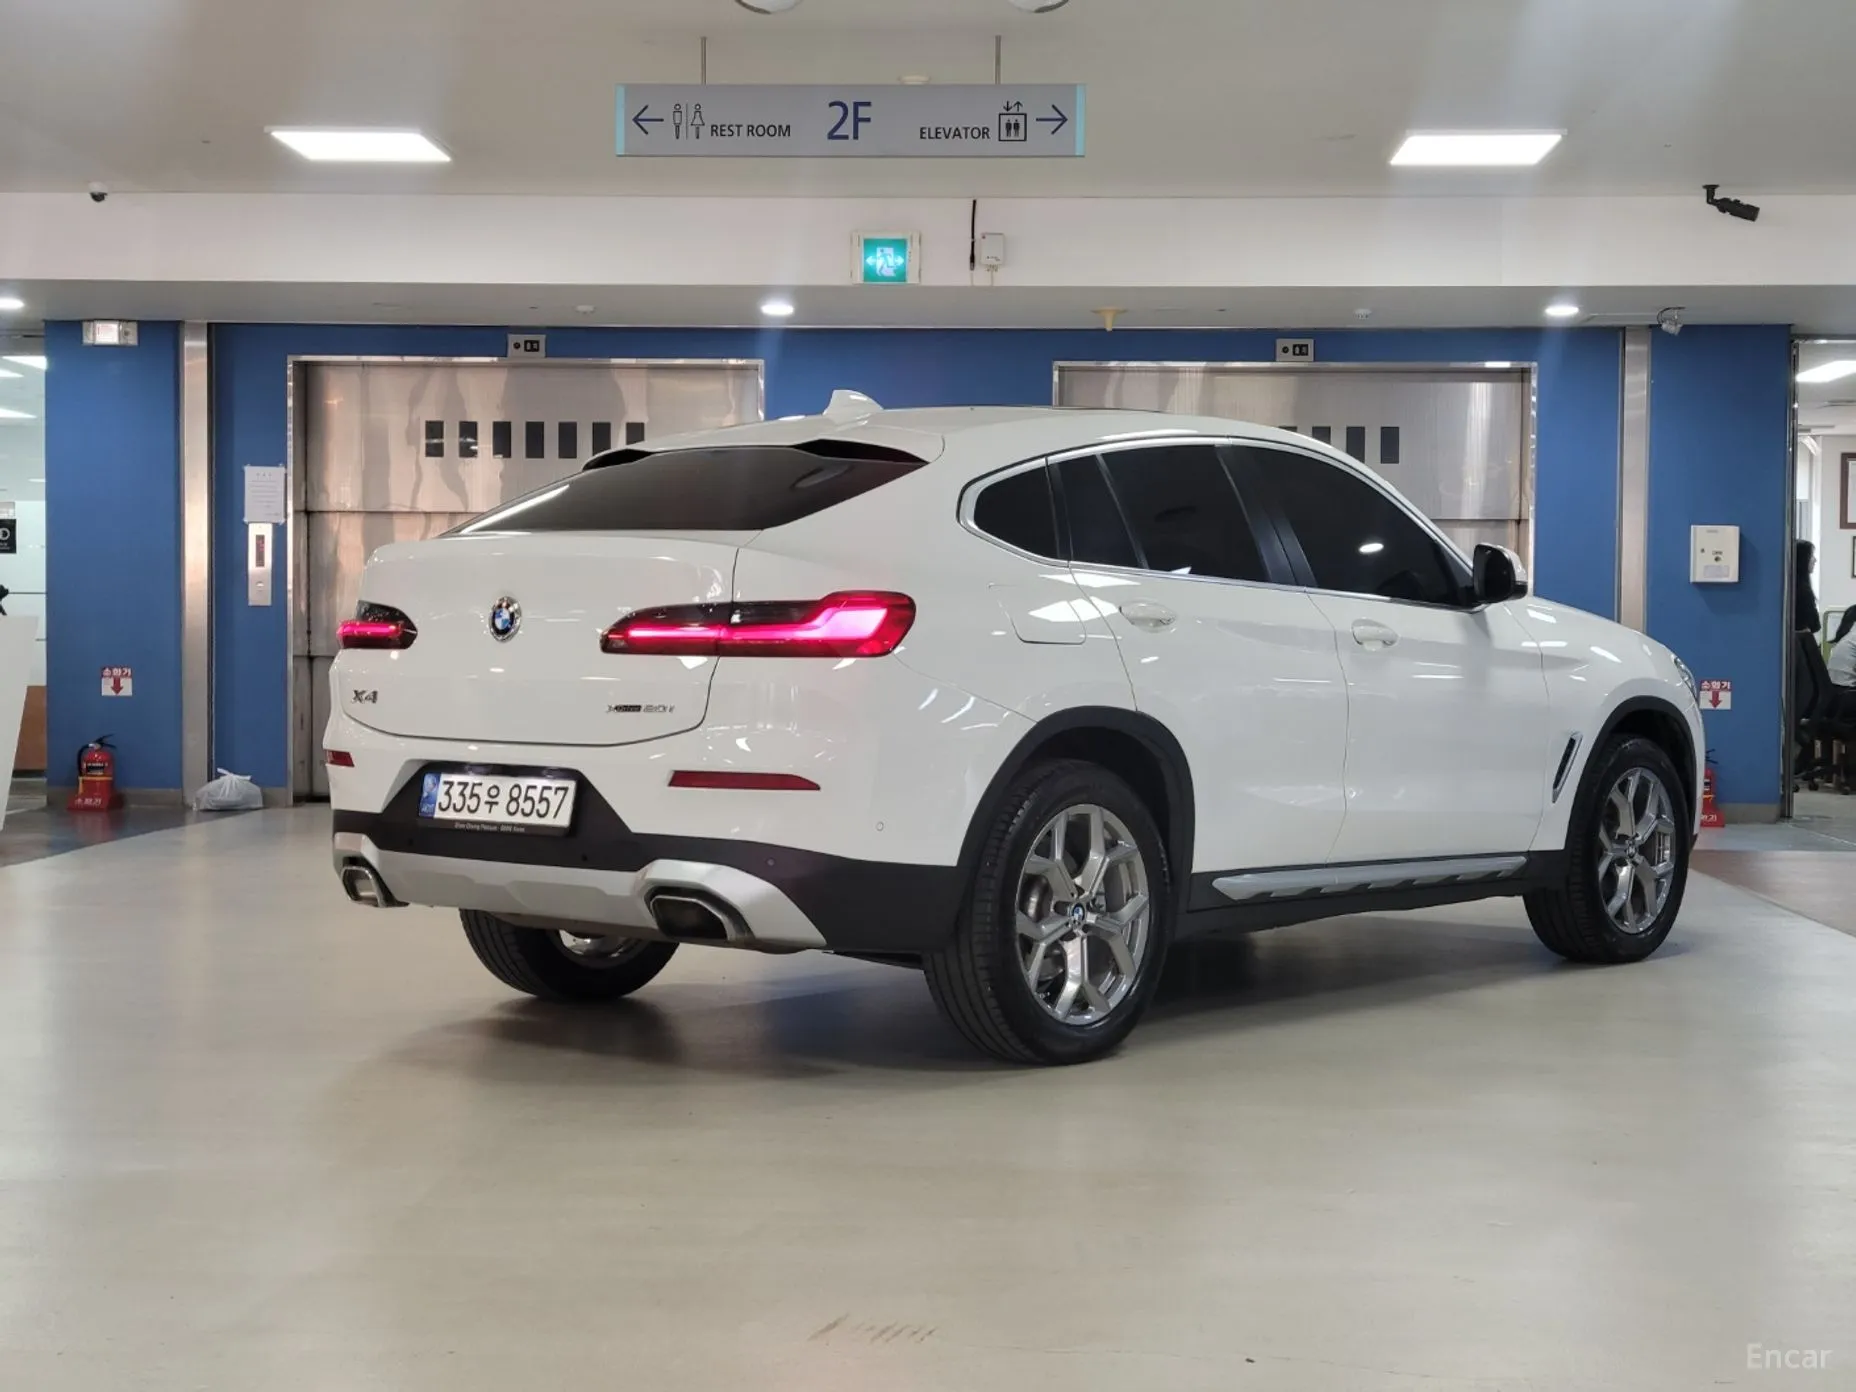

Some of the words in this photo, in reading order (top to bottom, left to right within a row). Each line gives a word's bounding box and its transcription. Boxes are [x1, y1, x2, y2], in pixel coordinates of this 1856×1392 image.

[826, 101, 872, 141] 2F
[710, 124, 743, 138] REST
[746, 124, 791, 138] ROOM
[919, 126, 990, 140] ELEVATOR
[102, 667, 131, 677] 소화기
[1701, 680, 1730, 690] 소화기
[353, 690, 378, 704] X4
[506, 783, 569, 819] 8557
